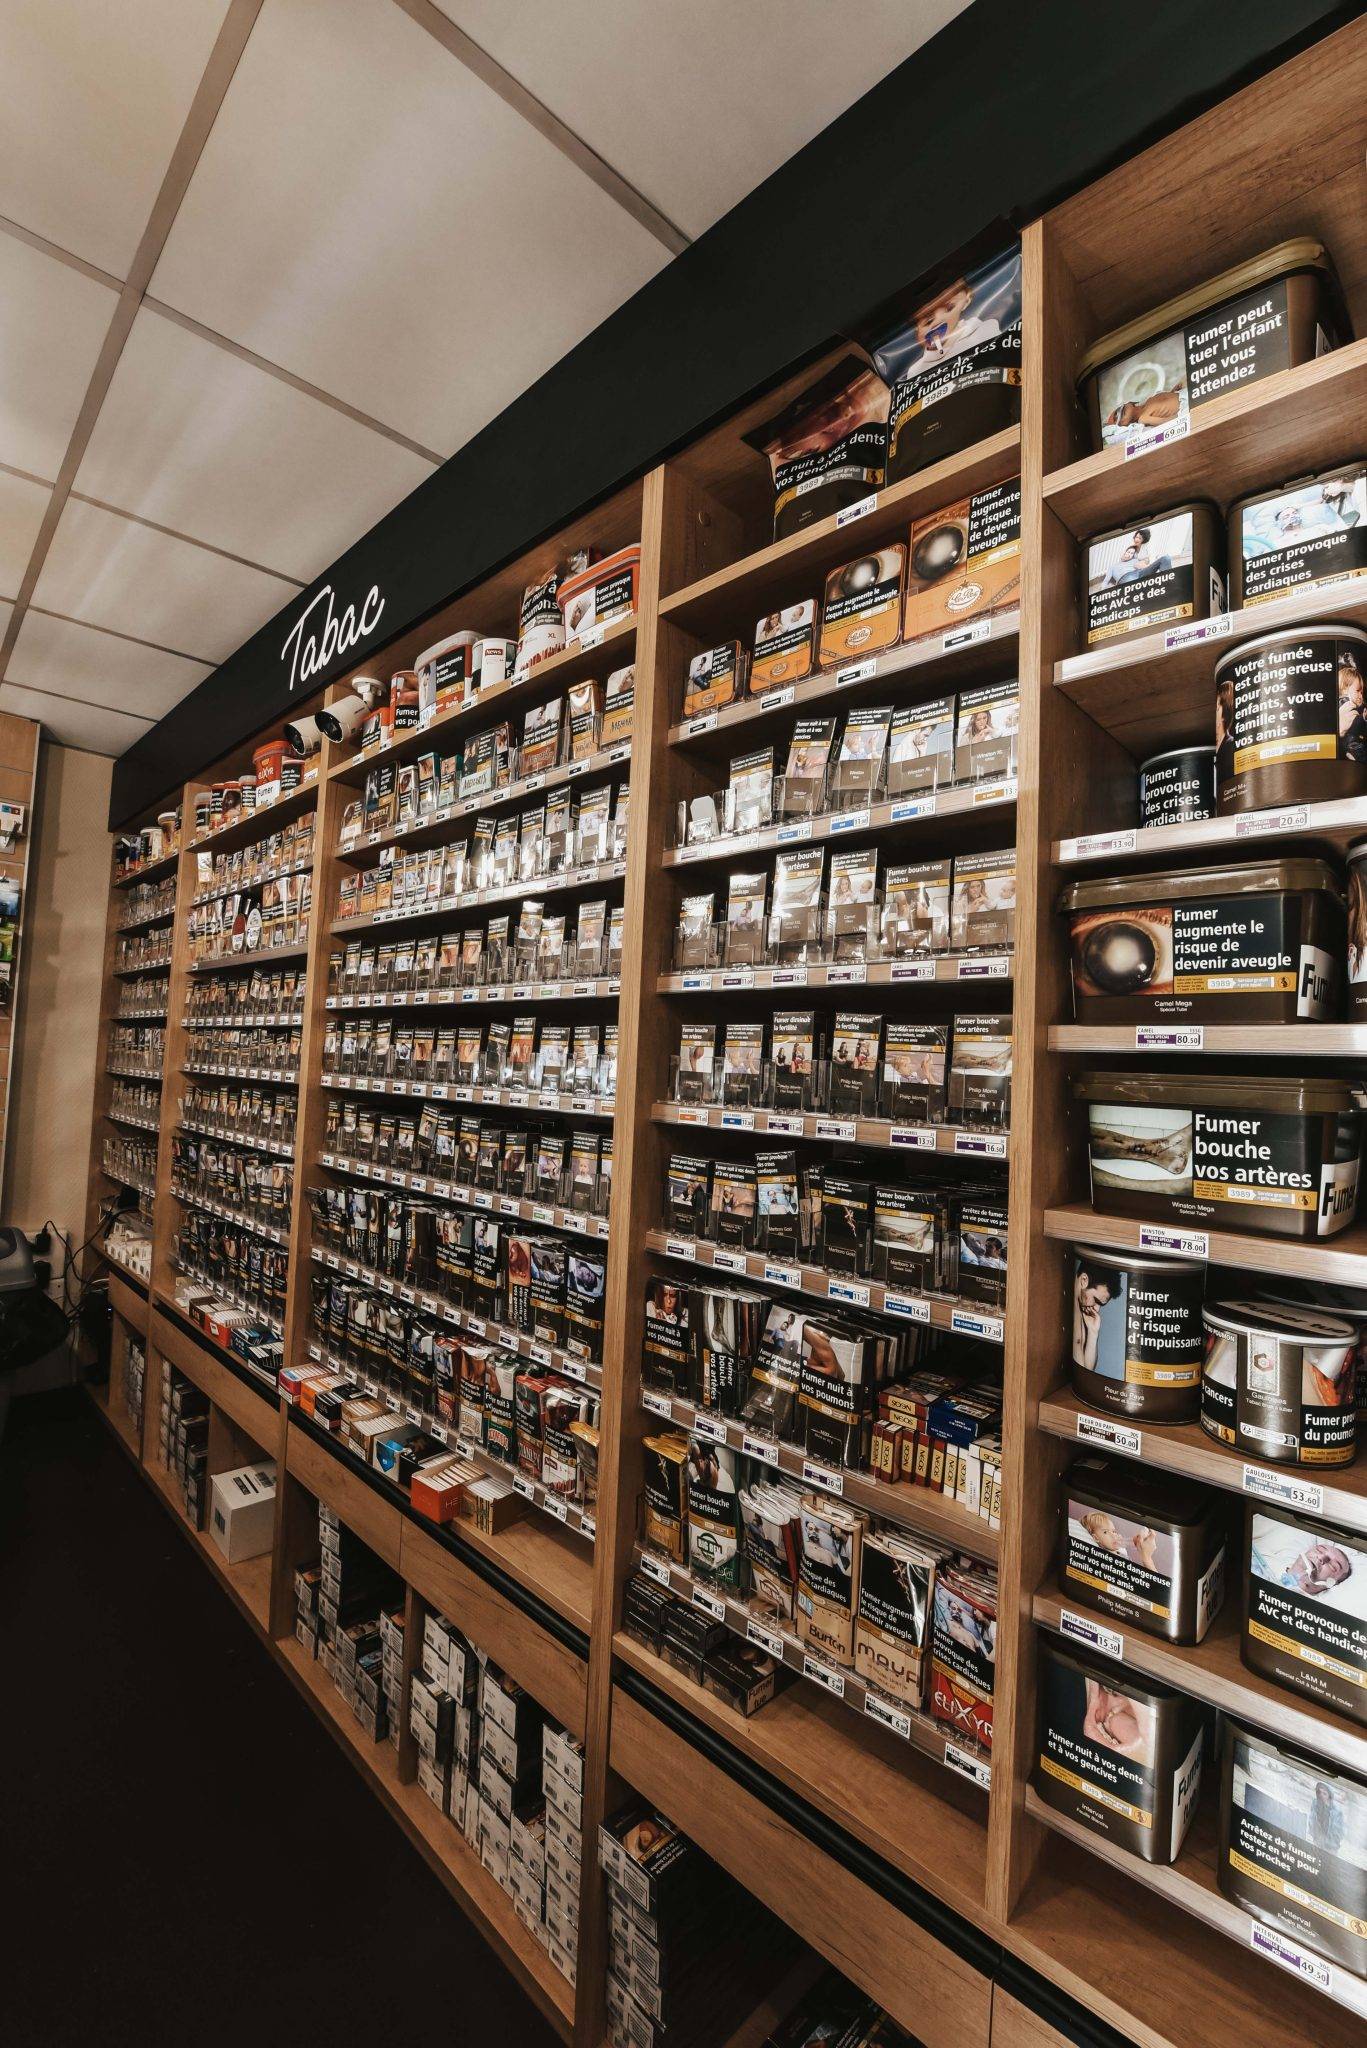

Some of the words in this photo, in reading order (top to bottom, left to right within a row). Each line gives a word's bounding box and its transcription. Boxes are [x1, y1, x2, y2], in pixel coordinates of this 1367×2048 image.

[1188, 319, 1231, 349] Fumer
[1238, 300, 1273, 330] peut
[1189, 341, 1219, 366] tuer
[1223, 314, 1282, 351] l'enfant
[1190, 362, 1217, 383] que
[1221, 345, 1256, 368] vous
[917, 362, 973, 394] fumeurs
[1191, 362, 1256, 399] attendez
[849, 432, 885, 446] dents
[775, 478, 794, 491] vos
[796, 452, 847, 478] gencives
[971, 491, 1020, 519] augmente
[972, 487, 1003, 507] Fumer
[970, 518, 980, 530] le
[981, 507, 1011, 527] risque
[970, 529, 981, 542] de
[983, 515, 1021, 538] devenir
[969, 532, 1008, 554] aveugle
[1246, 552, 1283, 571] Fumer
[1286, 533, 1348, 559] provoque
[1246, 569, 1266, 583] des
[1269, 559, 1305, 575] crises
[1246, 569, 1312, 596] cardiaques
[1091, 585, 1123, 605] Fumer
[1124, 572, 1175, 595] provoque
[1090, 602, 1109, 616] des
[1110, 592, 1133, 610] AVC
[1134, 592, 1144, 602] et
[1147, 587, 1166, 599] des
[1090, 606, 1141, 629] handicaps
[281, 585, 385, 690] Tabac
[1234, 654, 1265, 678] Votre
[1269, 646, 1313, 667] fumée
[1234, 679, 1251, 692] est
[1253, 661, 1333, 689] dangereuse
[1235, 690, 1260, 709] pour
[1264, 680, 1287, 695] vos
[1235, 699, 1284, 720] enfants,
[1287, 691, 1324, 705] votre
[1235, 716, 1276, 734] famille
[1280, 709, 1295, 721] et
[1235, 736, 1254, 749] vos
[1256, 725, 1288, 743] amis
[1145, 767, 1178, 785] Fumer
[1145, 779, 1200, 803] provoque
[1145, 802, 1161, 816] des
[1163, 793, 1200, 810] crises
[1145, 808, 1210, 829] cardiaques
[888, 866, 907, 877] Fumer
[908, 864, 930, 874] bouche
[1174, 908, 1218, 922] Fumer
[1174, 922, 1247, 939] augmente
[1250, 920, 1265, 933] le
[1174, 940, 1217, 959] risque
[1221, 938, 1240, 952] de
[1174, 956, 1227, 971] devenir
[1231, 952, 1292, 973] aveugle
[956, 1017, 976, 1026] Fumer
[976, 1017, 999, 1026] bouche
[1177, 1035, 1198, 1045] 80.50
[1195, 1113, 1260, 1136] Fumer
[1195, 1136, 1271, 1160] bouche
[1195, 1164, 1230, 1180] vos
[1235, 1165, 1313, 1188] artères
[1171, 1201, 1196, 1210] Winston
[1197, 1204, 1215, 1213] Mega
[1181, 1241, 1203, 1252] 78.00
[1128, 1287, 1169, 1304] Fumer
[1128, 1305, 1189, 1320] augmente
[1128, 1317, 1140, 1330] le
[1143, 1320, 1181, 1336] risque
[801, 1369, 826, 1386] Fumer
[827, 1379, 844, 1392] nuit
[801, 1382, 814, 1394] vos
[815, 1388, 855, 1411] poumons
[1204, 1386, 1234, 1407] cancers
[1305, 1413, 1340, 1426] Fumer
[1304, 1428, 1321, 1441] du
[1245, 1467, 1278, 1482] GAULOISES
[1292, 1490, 1317, 1506] 53.60
[1069, 1557, 1093, 1574] famille
[1094, 1566, 1102, 1576] et
[1103, 1571, 1115, 1582] vos
[1116, 1575, 1134, 1593] amis
[1070, 1549, 1087, 1565] pour
[1087, 1557, 1100, 1567] vos
[1101, 1560, 1129, 1582] enfants,
[1130, 1575, 1151, 1590] votre
[1071, 1538, 1089, 1552] Votre
[1090, 1545, 1113, 1563] fumée
[1114, 1556, 1125, 1567] est
[1126, 1563, 1172, 1588] dangereuse
[861, 1588, 881, 1606] Fumer
[867, 1599, 886, 1618] risque
[860, 1606, 883, 1627] devenir
[885, 1620, 913, 1641] aveugle
[1258, 1589, 1292, 1612] Fumer
[1295, 1605, 1349, 1637] provoque
[1258, 1602, 1279, 1621] AVC
[1281, 1612, 1294, 1626] et
[1295, 1617, 1315, 1635] des
[808, 1623, 846, 1655] Burton
[934, 1626, 954, 1647] Fumer
[1098, 1635, 1118, 1652] 15.50
[933, 1638, 965, 1665] provoque
[966, 1658, 979, 1673] des
[933, 1648, 951, 1664] crises
[952, 1659, 992, 1692] cardiaques
[1300, 1671, 1318, 1685] L&M
[1048, 1728, 1073, 1748] Fumer
[1075, 1742, 1092, 1757] nuit
[1094, 1751, 1100, 1762] à
[1101, 1759, 1117, 1772] vos
[1118, 1764, 1144, 1785] dents
[1048, 1739, 1057, 1748] et
[1057, 1742, 1064, 1751] à
[1065, 1748, 1079, 1762] vos
[1080, 1755, 1118, 1784] gencives
[1240, 1829, 1266, 1848] restez
[1268, 1843, 1280, 1854] en
[1281, 1847, 1295, 1862] vie
[1296, 1858, 1320, 1877] pour
[1241, 1818, 1273, 1841] Arrêtez
[1274, 1834, 1287, 1848] de
[1288, 1841, 1316, 1864] fumer
[1240, 1839, 1254, 1852] vos
[1255, 1847, 1292, 1872] proches
[1283, 1907, 1311, 1928] Interval
[1254, 1923, 1282, 1943] INTERVAL
[1301, 1962, 1326, 1982] 49.50
